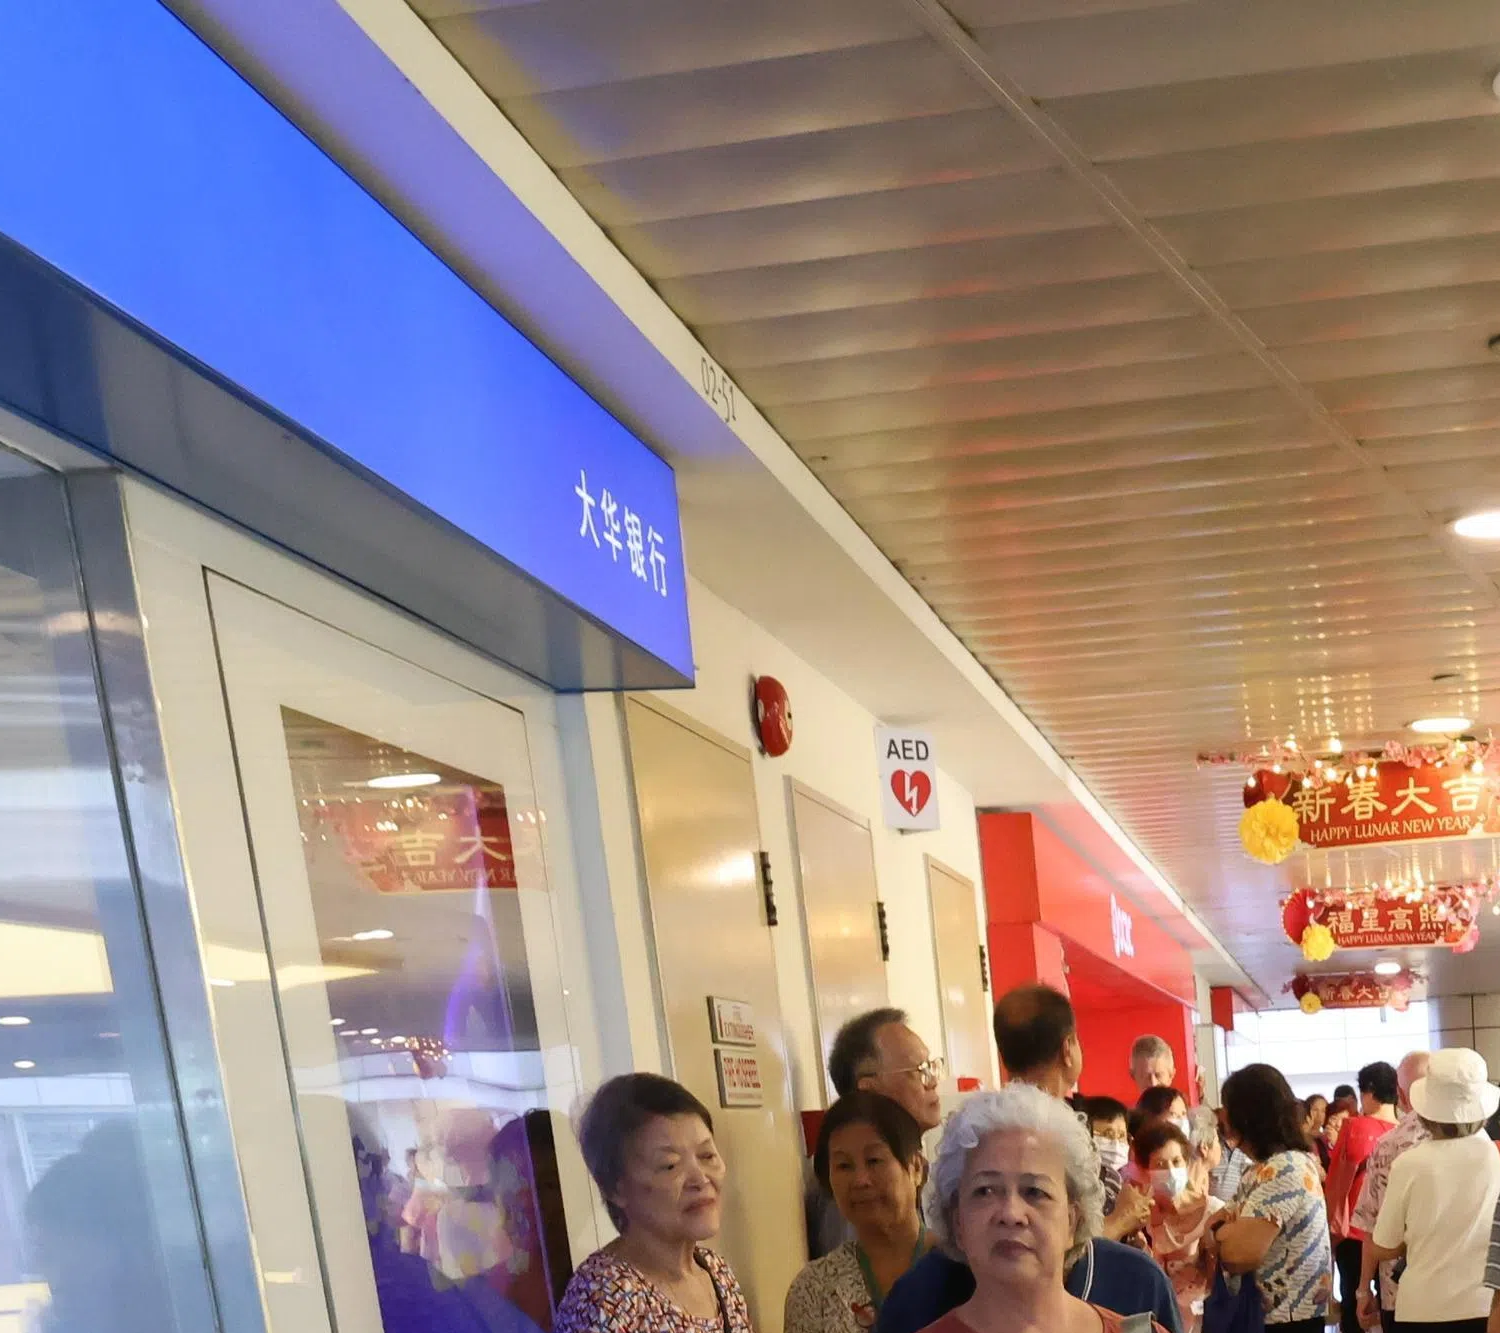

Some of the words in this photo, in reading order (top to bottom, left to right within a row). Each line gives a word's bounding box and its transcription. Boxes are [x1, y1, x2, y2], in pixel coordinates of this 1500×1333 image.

[575, 469, 667, 597] 大华银行
[887, 738, 929, 761] AED
[1292, 774, 1486, 825] 新春大吉
[1310, 827, 1351, 842] HAPPY
[1354, 822, 1400, 839] LUNAR
[1403, 819, 1434, 834] NEW
[1436, 815, 1472, 831] YEAR
[1337, 934, 1363, 945] HAPPY
[1364, 933, 1394, 944] LUNAR
[1395, 932, 1416, 943] NEW
[1417, 931, 1438, 942] YEAR
